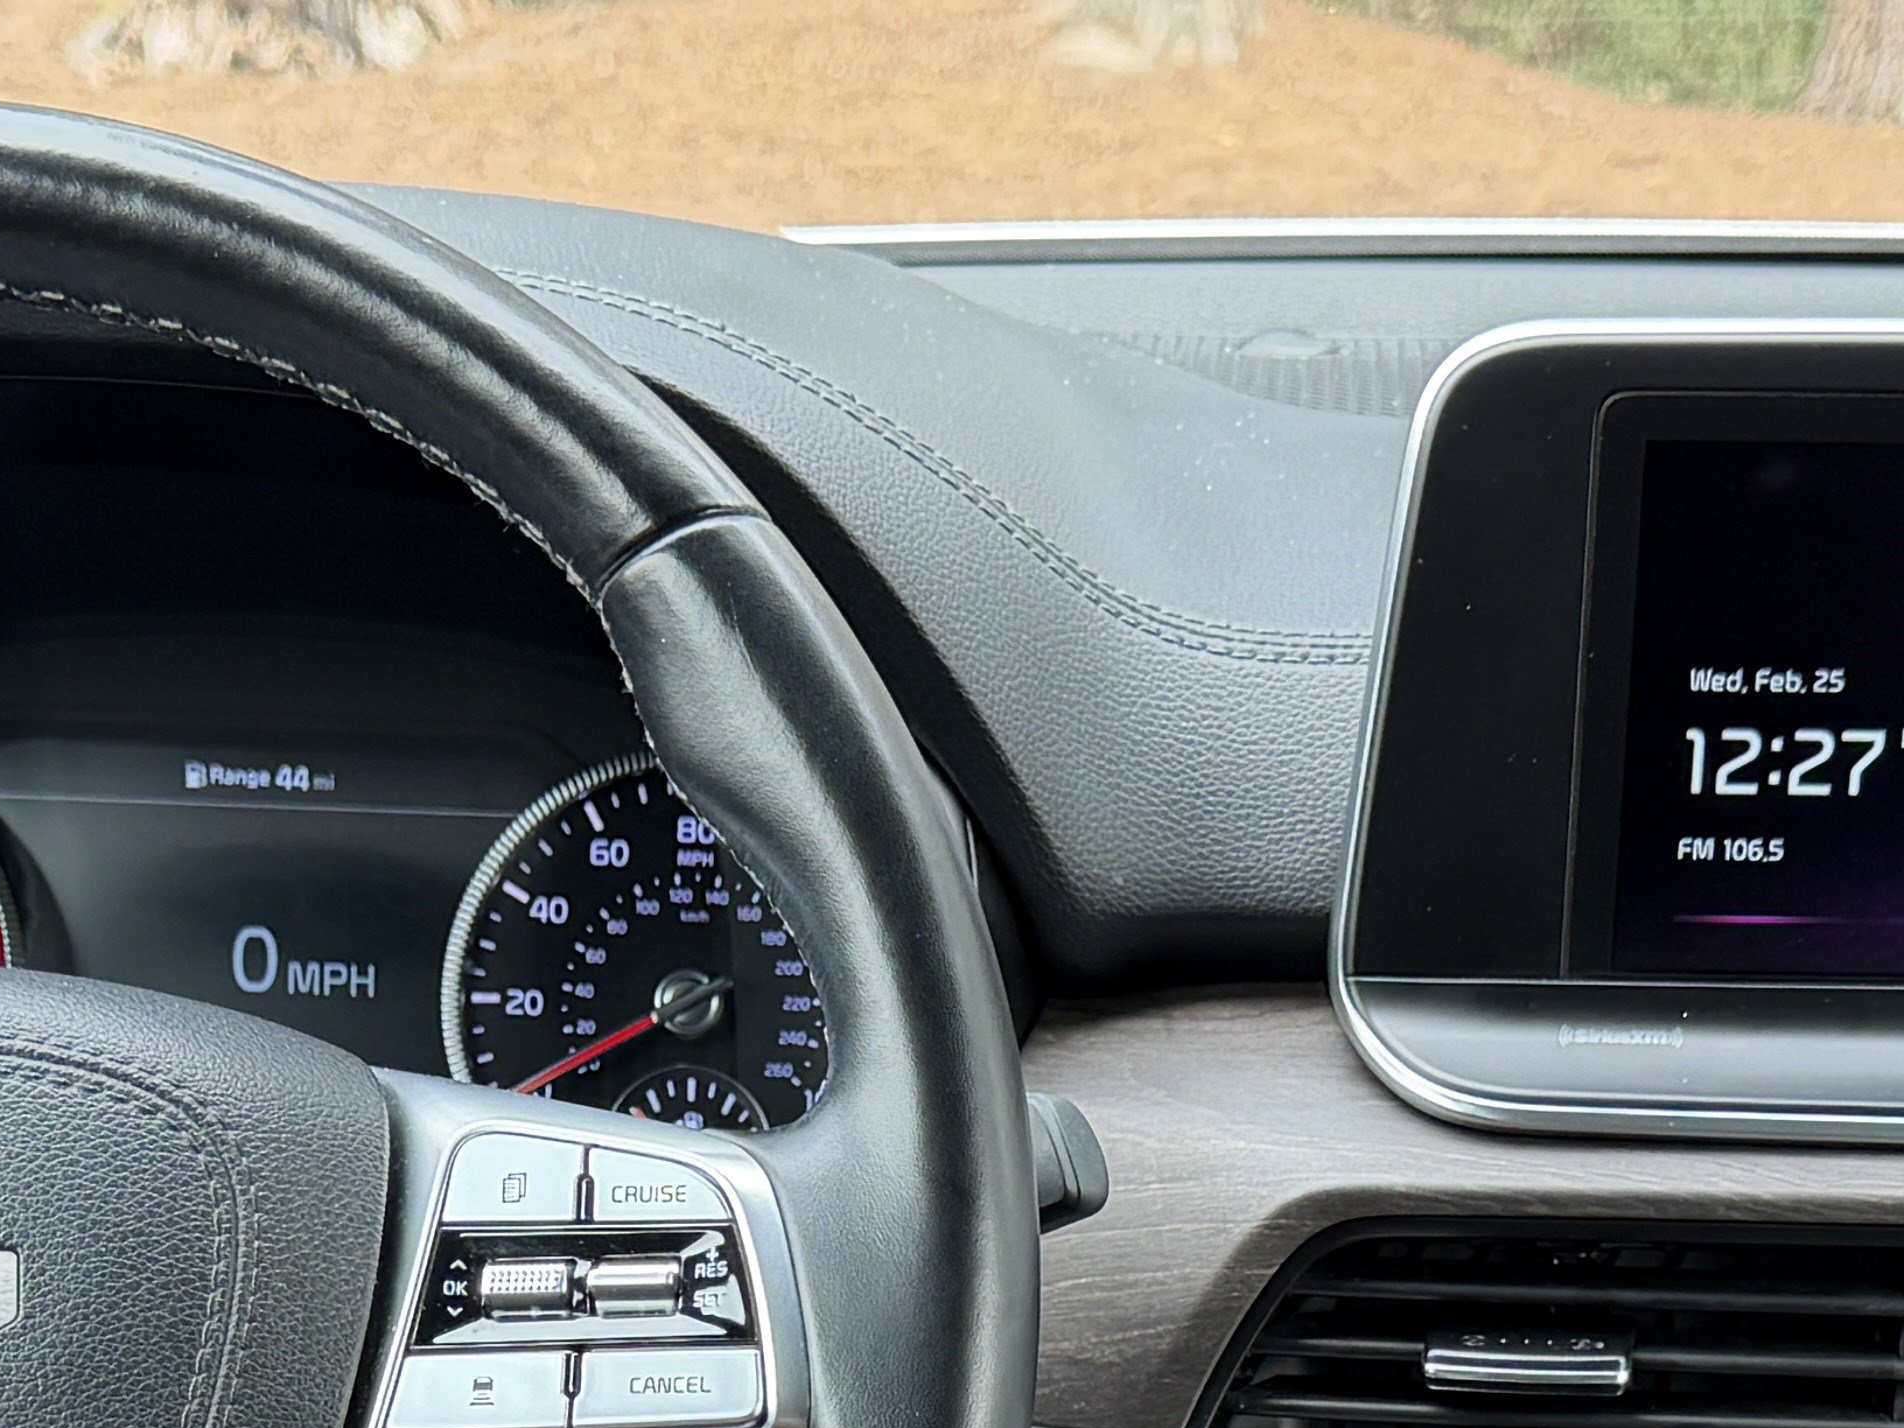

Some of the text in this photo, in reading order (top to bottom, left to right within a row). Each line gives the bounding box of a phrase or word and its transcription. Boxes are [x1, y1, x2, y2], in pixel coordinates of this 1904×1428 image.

[1689, 667, 1846, 695] Wed, Feb. 25
[1684, 726, 1887, 797] 12:27
[209, 762, 271, 789] Range
[275, 763, 310, 791] 44
[676, 815, 716, 845] 80
[589, 837, 630, 868] 60
[676, 849, 715, 868] MPH
[1677, 837, 1785, 864] FM 106.5
[528, 895, 569, 925] 40
[232, 924, 377, 998] 0 MPH
[505, 988, 544, 1018] 20
[611, 1184, 688, 1204] CRUISE
[694, 1260, 729, 1280] RES
[442, 1279, 469, 1297] OK
[629, 1375, 712, 1395] CANCEL
